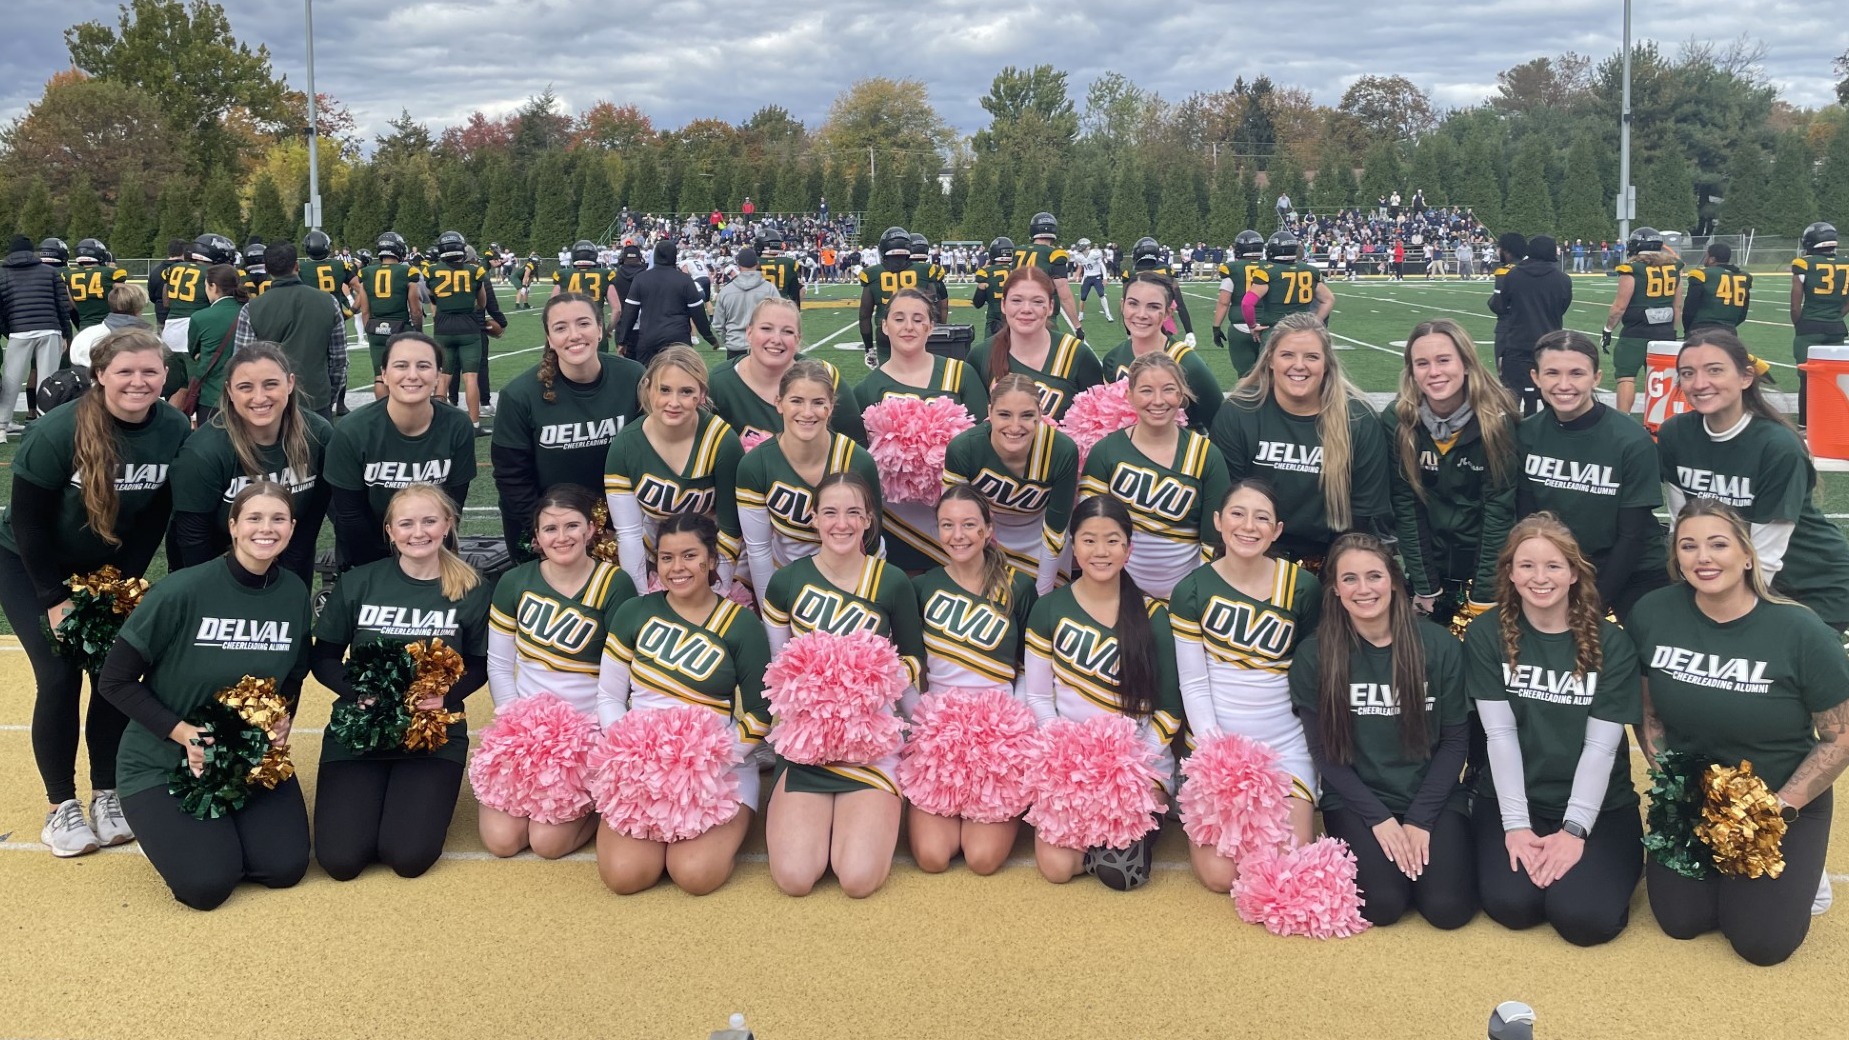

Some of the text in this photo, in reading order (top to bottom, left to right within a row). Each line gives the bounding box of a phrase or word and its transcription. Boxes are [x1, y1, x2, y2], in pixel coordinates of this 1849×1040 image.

[1015, 250, 1038, 268] 74
[70, 271, 105, 301] 54
[167, 266, 201, 302] 93
[316, 265, 336, 293] 6
[374, 269, 392, 298] 0
[434, 269, 472, 298] 20
[567, 272, 601, 302] 43
[760, 264, 785, 291] 51
[879, 271, 918, 305] 98
[1281, 270, 1313, 304] 78
[1646, 264, 1677, 297] 66
[1715, 274, 1748, 307] 46
[1814, 263, 1849, 296] 37
[1647, 371, 1664, 398] G
[1254, 440, 1325, 466] DELVA
[1273, 462, 1320, 474] CHEERLEADING
[1524, 453, 1621, 489] DELVAL
[634, 473, 716, 515] DVU
[970, 468, 1051, 512] DVU
[1109, 461, 1197, 521] DVU
[1544, 478, 1617, 496] CHEERLEADING ALUMNI
[766, 481, 818, 528] DV
[196, 616, 293, 643] DELVAL
[357, 604, 460, 628] DELVAL
[517, 590, 598, 654] DVU
[924, 589, 1010, 650] DVU
[1201, 595, 1295, 659] DVU
[222, 642, 291, 651] CHEERLEADING ALUMNI
[380, 626, 456, 637] CHEERLEADING ALUMNI
[636, 616, 725, 682] DVU
[1650, 645, 1775, 684] DELVAL
[1518, 688, 1573, 705] CHEERLEADING
[1671, 671, 1769, 694] CHEERLEADING ALUMNI
